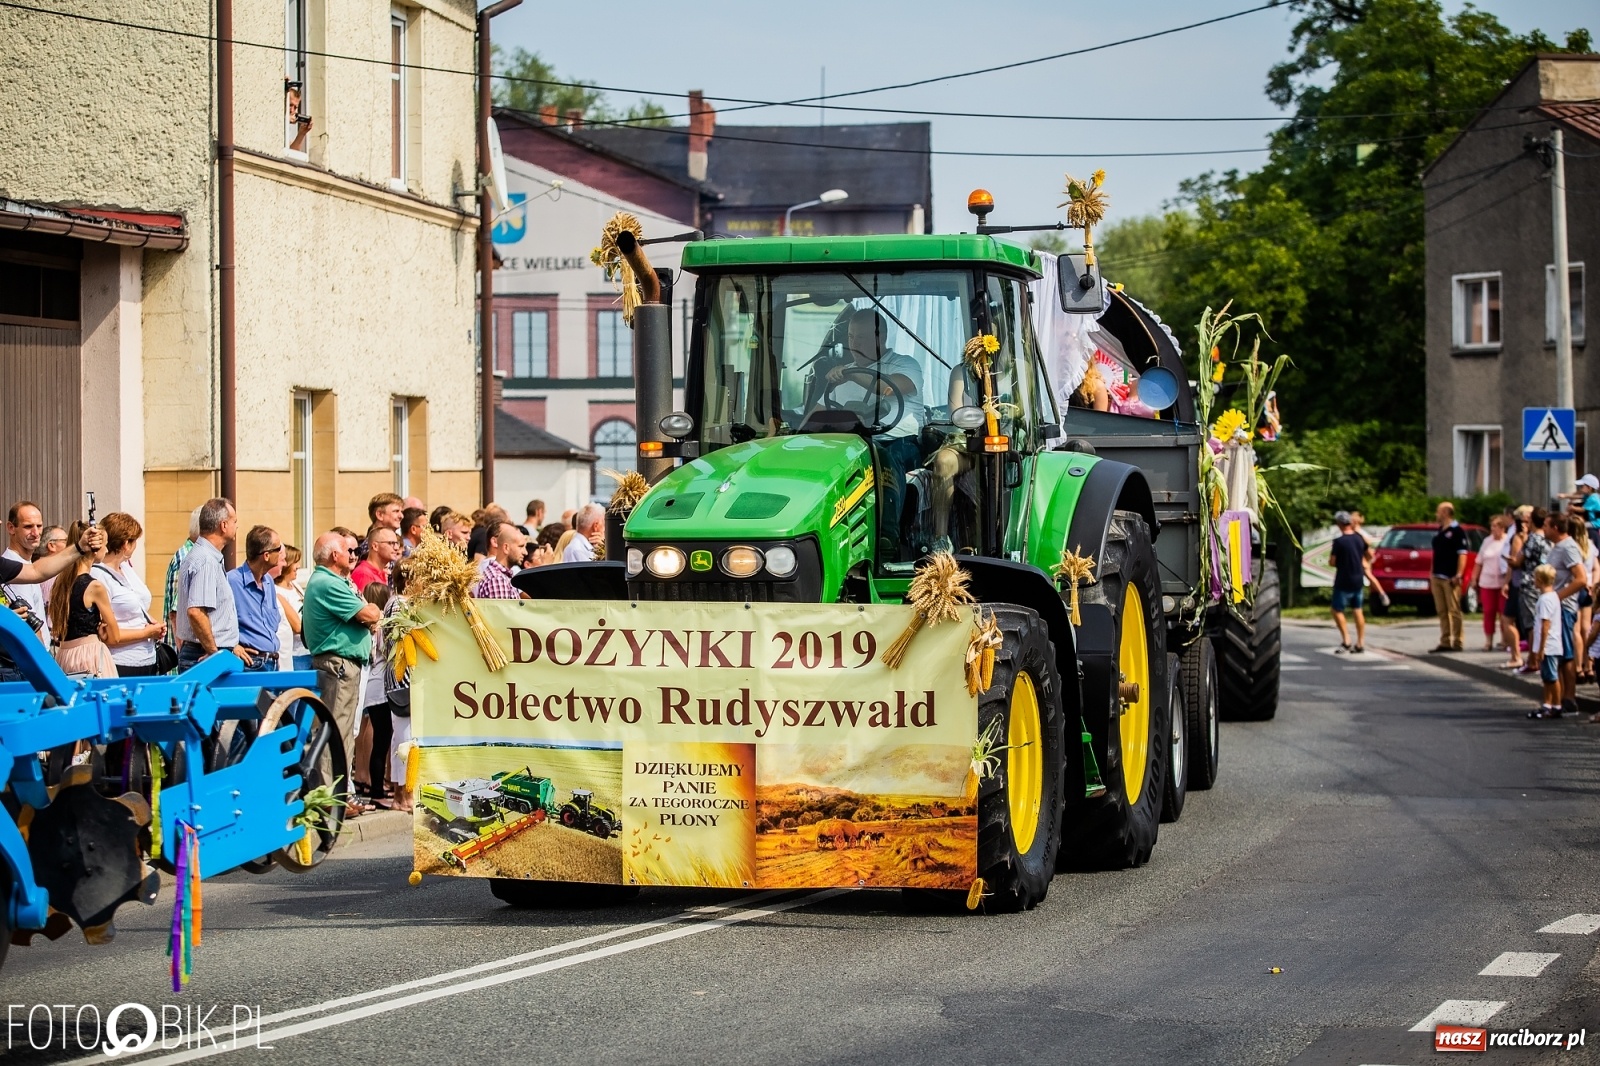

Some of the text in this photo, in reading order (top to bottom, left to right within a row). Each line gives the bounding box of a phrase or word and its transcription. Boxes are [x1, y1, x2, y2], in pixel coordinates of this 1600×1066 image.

[524, 256, 586, 271] WIELKIE
[507, 618, 878, 671] DOŻYNKI 2019
[452, 681, 937, 738] Sołectwo Rudyszwałd
[634, 761, 745, 779] DZIĘKUJEMY
[662, 780, 717, 795] PANIE
[629, 796, 750, 810] ZA TEGOROCZNE
[659, 813, 721, 827] PLONY
